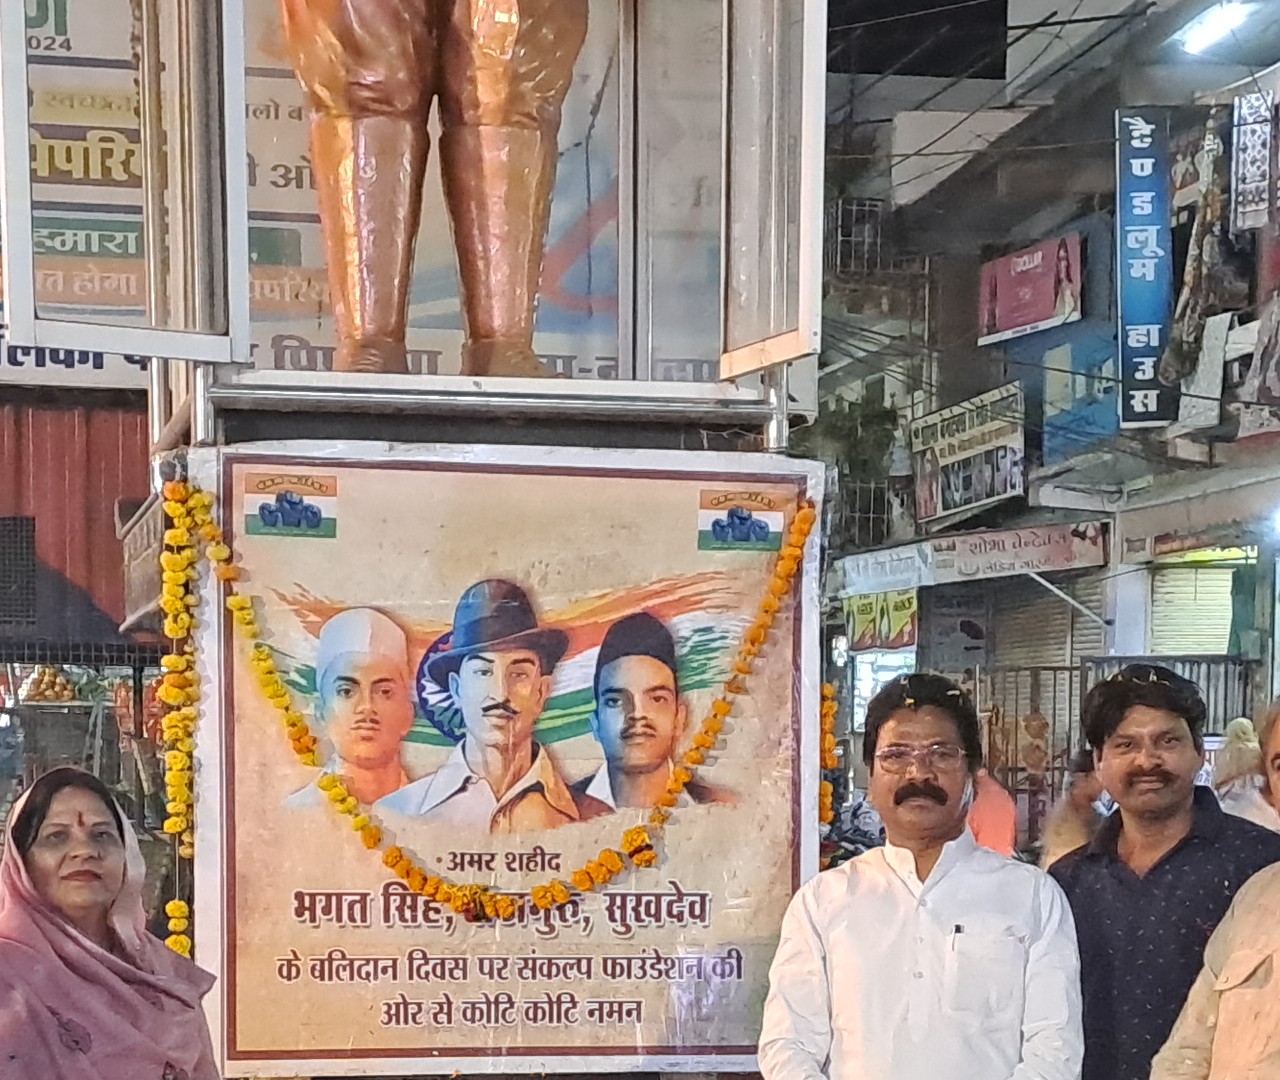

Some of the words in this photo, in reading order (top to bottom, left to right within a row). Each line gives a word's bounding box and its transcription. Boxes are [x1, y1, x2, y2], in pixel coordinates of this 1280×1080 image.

[27, 35, 72, 52] 024
[72, 263, 137, 296] होगा
[447, 851, 497, 872] अमर
[505, 845, 562, 872] शहीद
[293, 890, 372, 925] भगत
[381, 881, 455, 932] सिह,
[603, 880, 710, 935] सुखदेव
[276, 949, 302, 982] के
[309, 949, 398, 982] बलिदान
[408, 949, 469, 982] दिवस
[478, 956, 510, 981] पर
[517, 949, 593, 981] संकल्प
[602, 949, 704, 981] फाउंडेशन
[712, 948, 743, 980] की
[381, 993, 424, 1026] ओर
[432, 993, 454, 1026] से
[461, 992, 516, 1026] कोटि
[524, 992, 580, 1025] कोटि
[587, 1000, 644, 1025] नमन
